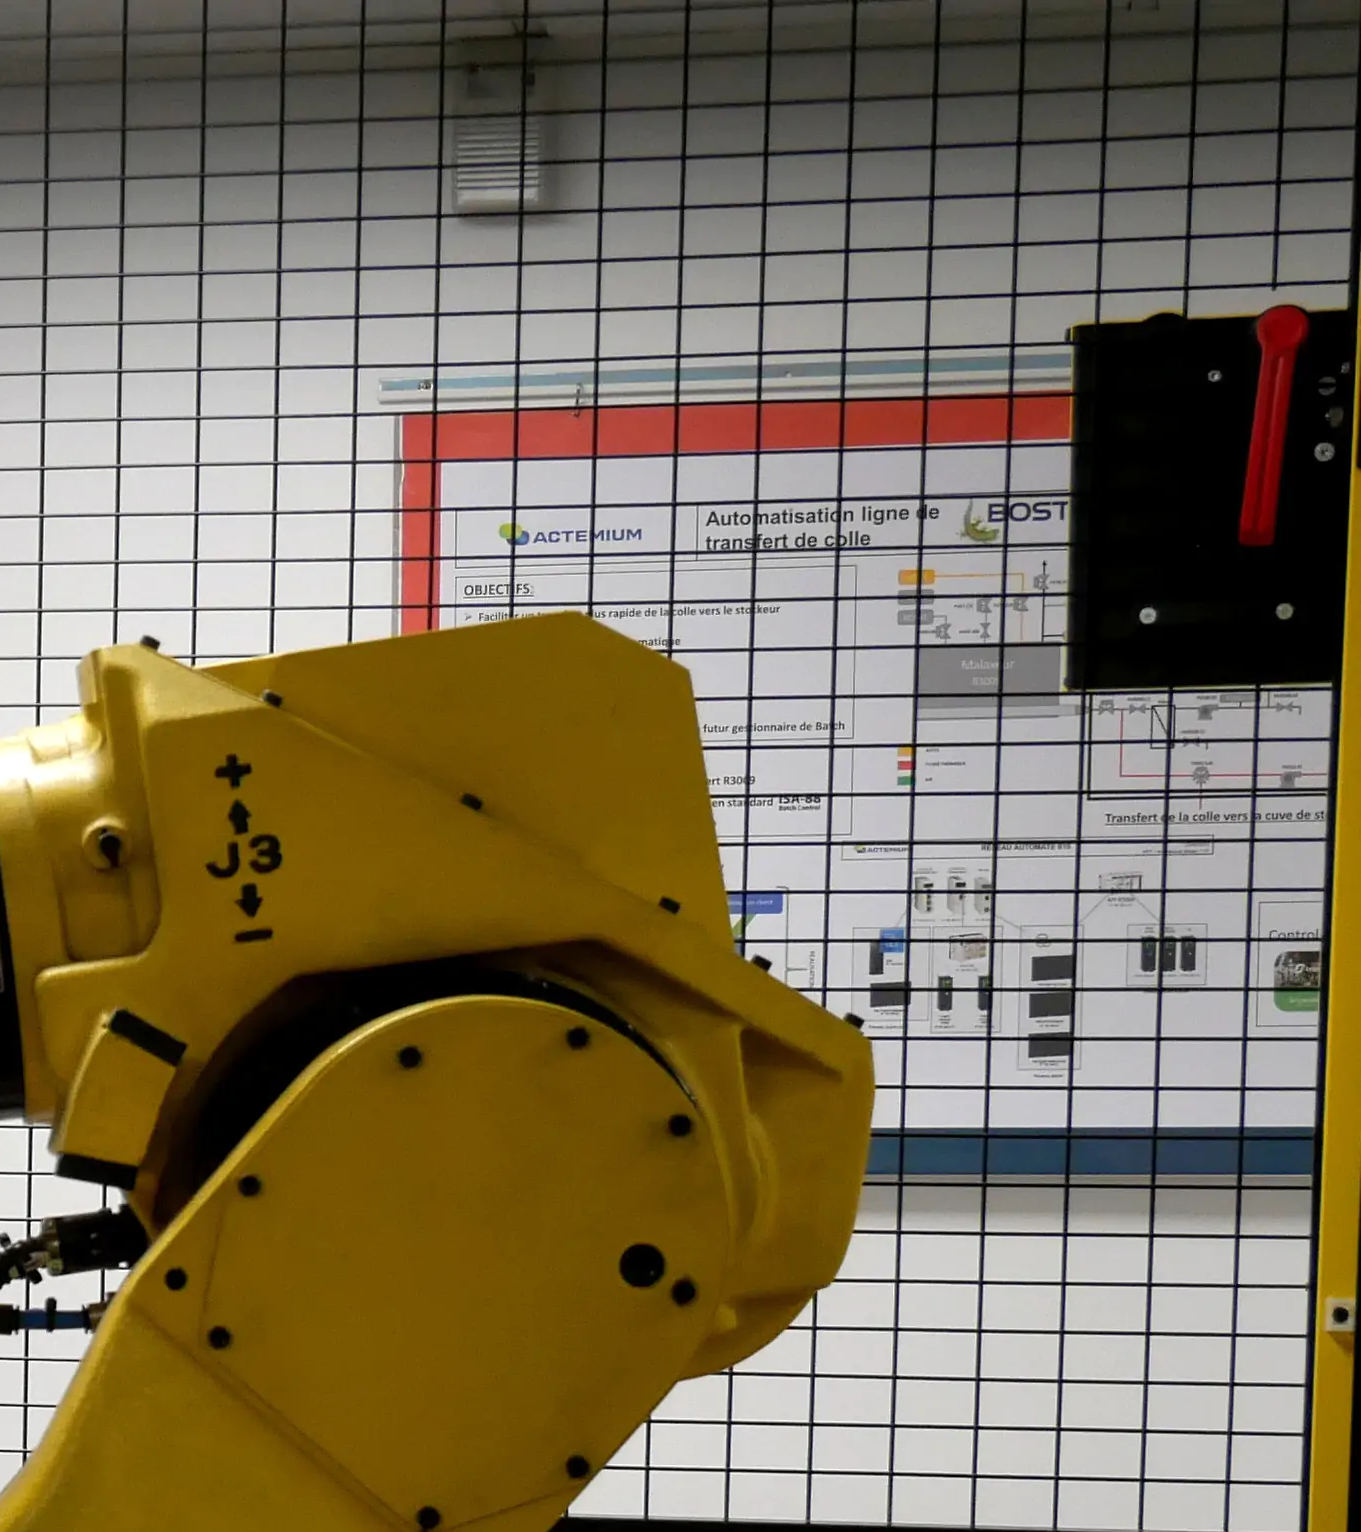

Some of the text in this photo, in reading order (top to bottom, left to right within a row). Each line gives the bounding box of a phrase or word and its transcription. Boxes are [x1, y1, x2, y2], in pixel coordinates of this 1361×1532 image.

[705, 503, 940, 527] Automatisation ligne de
[533, 528, 643, 544] ACTEMIUM
[705, 532, 789, 551] transfert
[794, 533, 819, 549] de
[463, 583, 534, 597] OBJECTFS:
[608, 606, 642, 620] rapide
[644, 605, 658, 616] de
[699, 605, 722, 614] vers
[723, 603, 733, 613] le
[703, 722, 813, 733] futur de
[1105, 810, 1312, 824] Transfert la colle vers cuve de
[205, 834, 283, 879] J3
